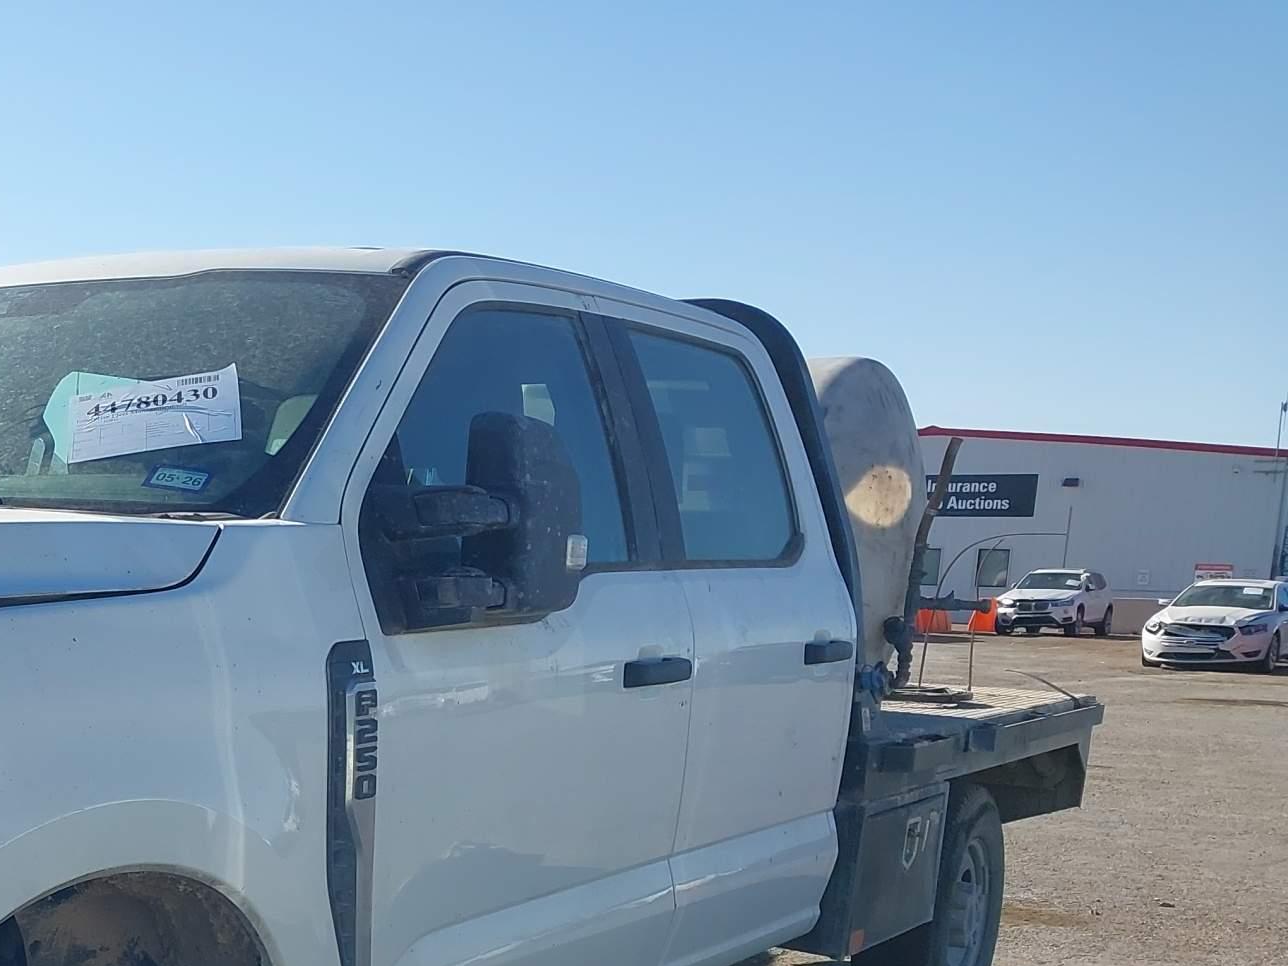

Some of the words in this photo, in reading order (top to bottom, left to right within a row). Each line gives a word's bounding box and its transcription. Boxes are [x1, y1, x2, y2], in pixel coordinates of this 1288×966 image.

[87, 386, 219, 417] 44780430
[927, 479, 997, 493] Inurance
[946, 495, 1010, 510] Auctions
[351, 661, 369, 675] XL
[354, 688, 379, 801] F250
